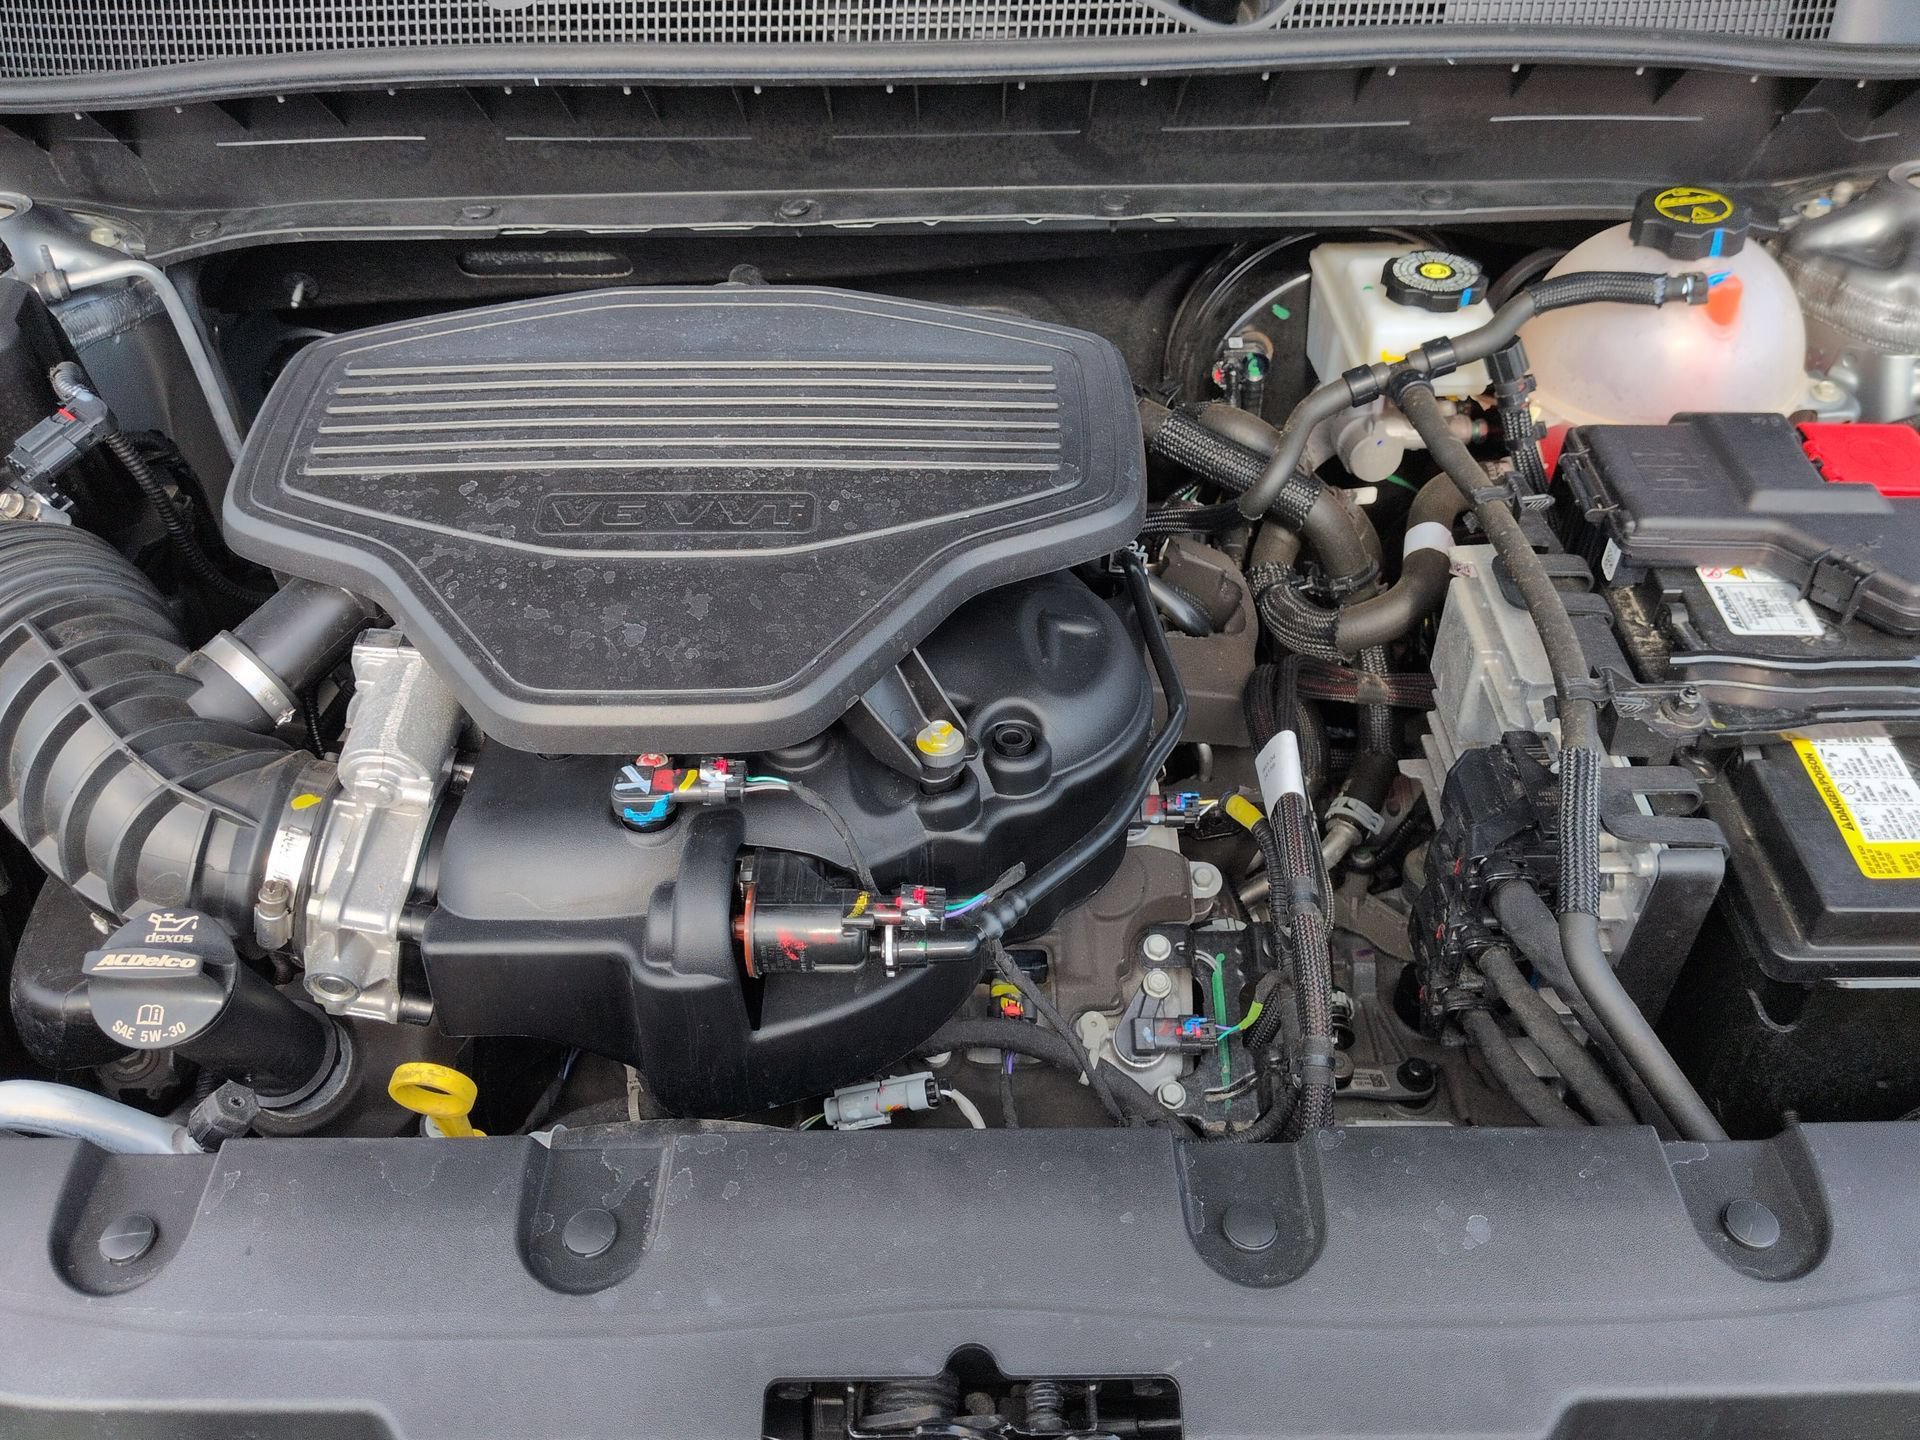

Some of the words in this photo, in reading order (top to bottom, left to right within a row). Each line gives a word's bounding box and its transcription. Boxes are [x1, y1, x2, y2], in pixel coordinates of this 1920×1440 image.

[551, 500, 648, 526] V6
[664, 500, 806, 525] VVT
[145, 932, 194, 944] dexos
[97, 953, 197, 969] ACDelco
[112, 1020, 136, 1040] SAE
[140, 1021, 187, 1043] 5W-30
